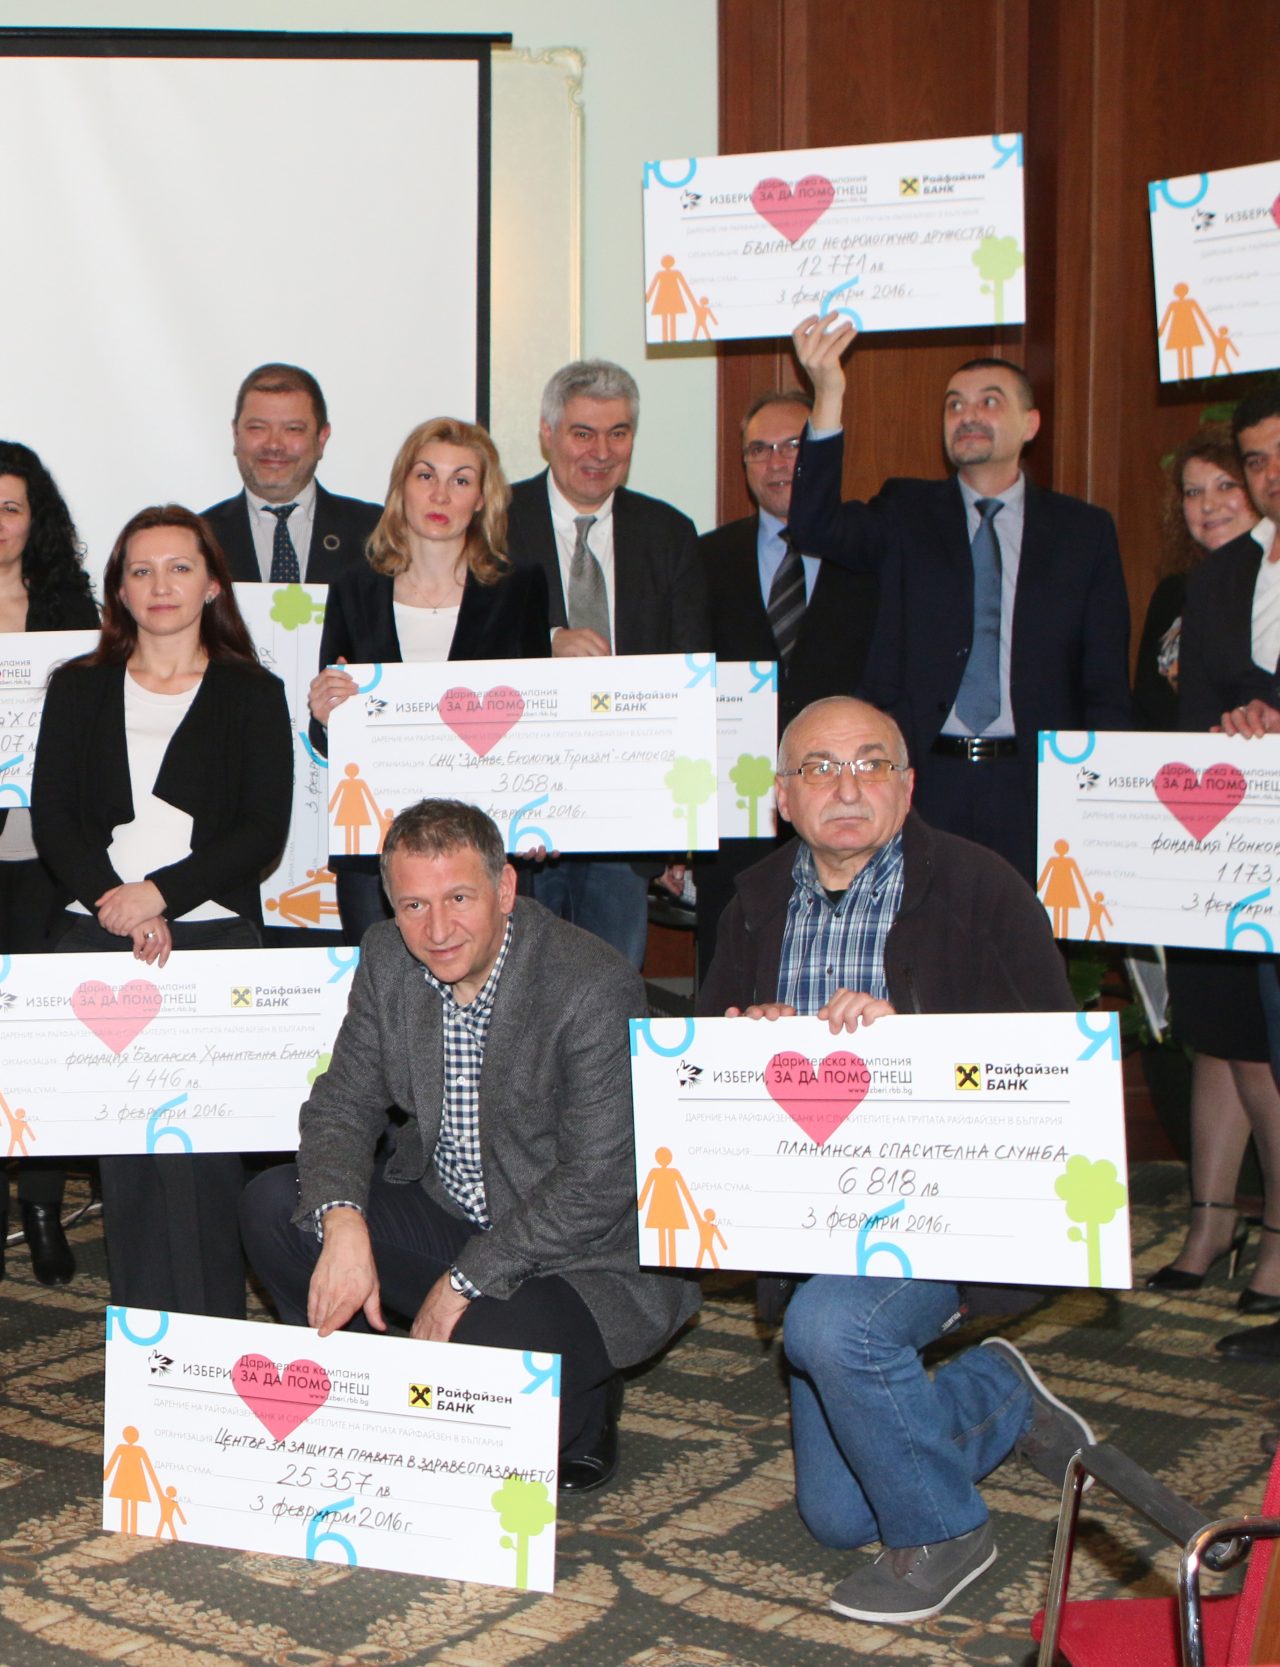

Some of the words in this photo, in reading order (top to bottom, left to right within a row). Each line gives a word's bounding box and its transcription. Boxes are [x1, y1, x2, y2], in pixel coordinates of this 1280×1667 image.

[614, 690, 678, 701] Райфайзен
[446, 702, 462, 711] ЗА
[466, 701, 482, 712] ДА
[487, 698, 558, 710] ПОМОГНЕШ
[614, 702, 647, 712] БАНК
[1162, 778, 1179, 788] ЗА
[1183, 779, 1201, 791] ДА
[255, 985, 321, 996] Райфайзен
[80, 996, 96, 1006] ЗА
[100, 995, 118, 1007] ДА
[122, 993, 196, 1005] ПОМОГНЕШ
[255, 997, 289, 1007] БАНК
[850, 1057, 912, 1066] кампания
[985, 1063, 1069, 1077] Райфайзен
[774, 1071, 793, 1083] ЗА
[798, 1071, 818, 1085] ДА
[824, 1070, 912, 1084] ПОМОГНЕШ
[986, 1079, 1029, 1091] БАНК
[838, 1167, 857, 1193] 6
[867, 1167, 916, 1196] 818
[802, 1207, 816, 1229] 3
[313, 1366, 370, 1380] кампания
[240, 1370, 258, 1382] ЗА
[263, 1372, 282, 1387] ДА
[287, 1375, 370, 1396] ПОМОГНЕШ
[436, 1385, 512, 1406] Райфайзен
[436, 1399, 475, 1414] БАНК
[277, 1464, 317, 1487] 25
[321, 1468, 372, 1494] 357
[250, 1496, 264, 1511] 3
